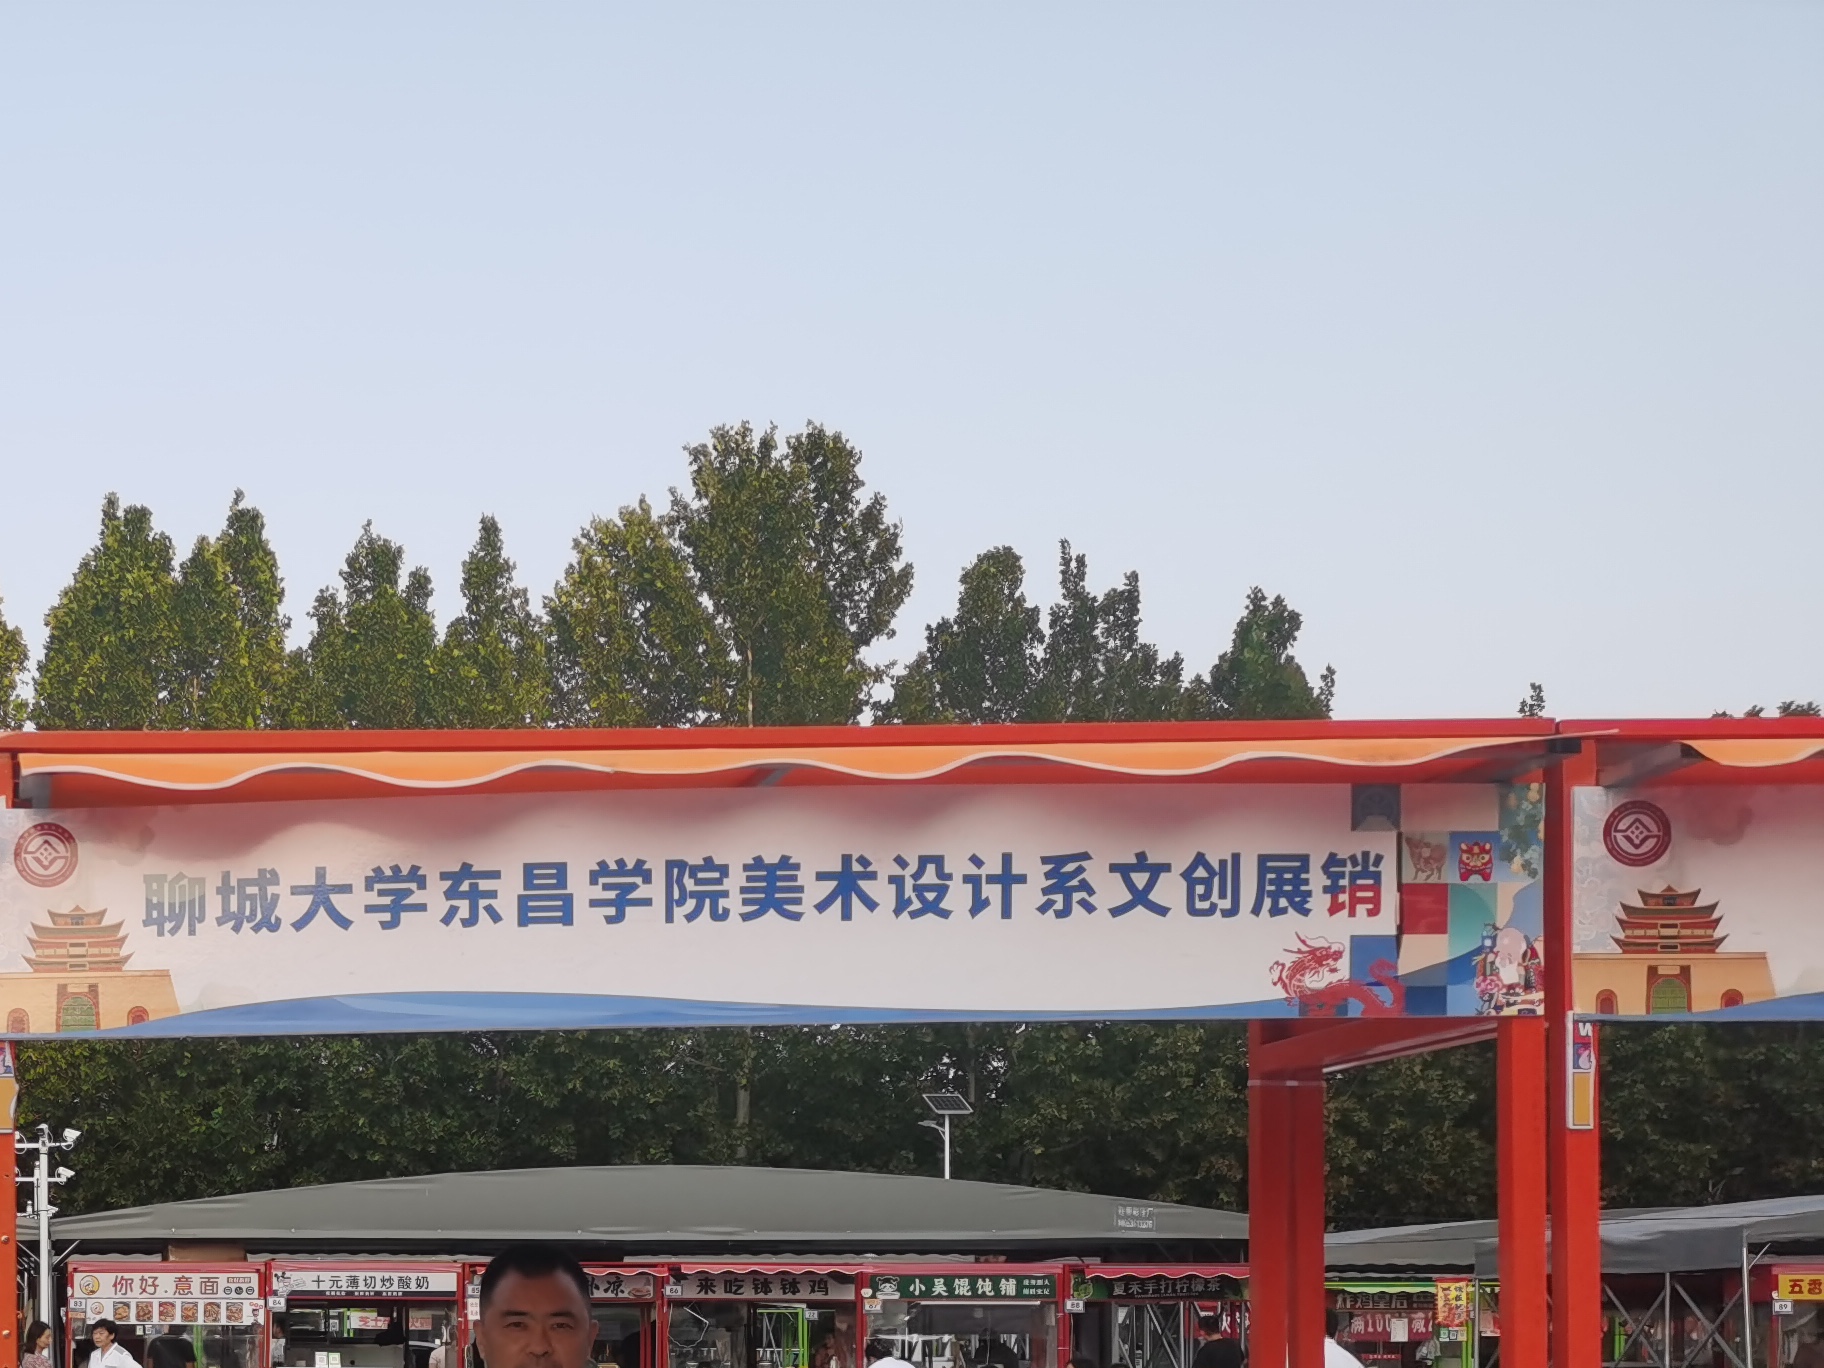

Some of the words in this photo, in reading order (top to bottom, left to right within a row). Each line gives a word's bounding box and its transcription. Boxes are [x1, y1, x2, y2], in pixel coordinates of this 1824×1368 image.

[141, 850, 1386, 938] 聊城大学东昌学院美术设计系文创展销
[311, 1275, 430, 1290] 十元薄切炒酸奶
[696, 1277, 829, 1296] 来吃钵钵鸡
[909, 1277, 1018, 1296] 小吴馄饨铺
[1112, 1278, 1221, 1296] 夏禾手打柠檬茶
[73, 1300, 83, 1308] 83
[1778, 1303, 1788, 1311] 89
